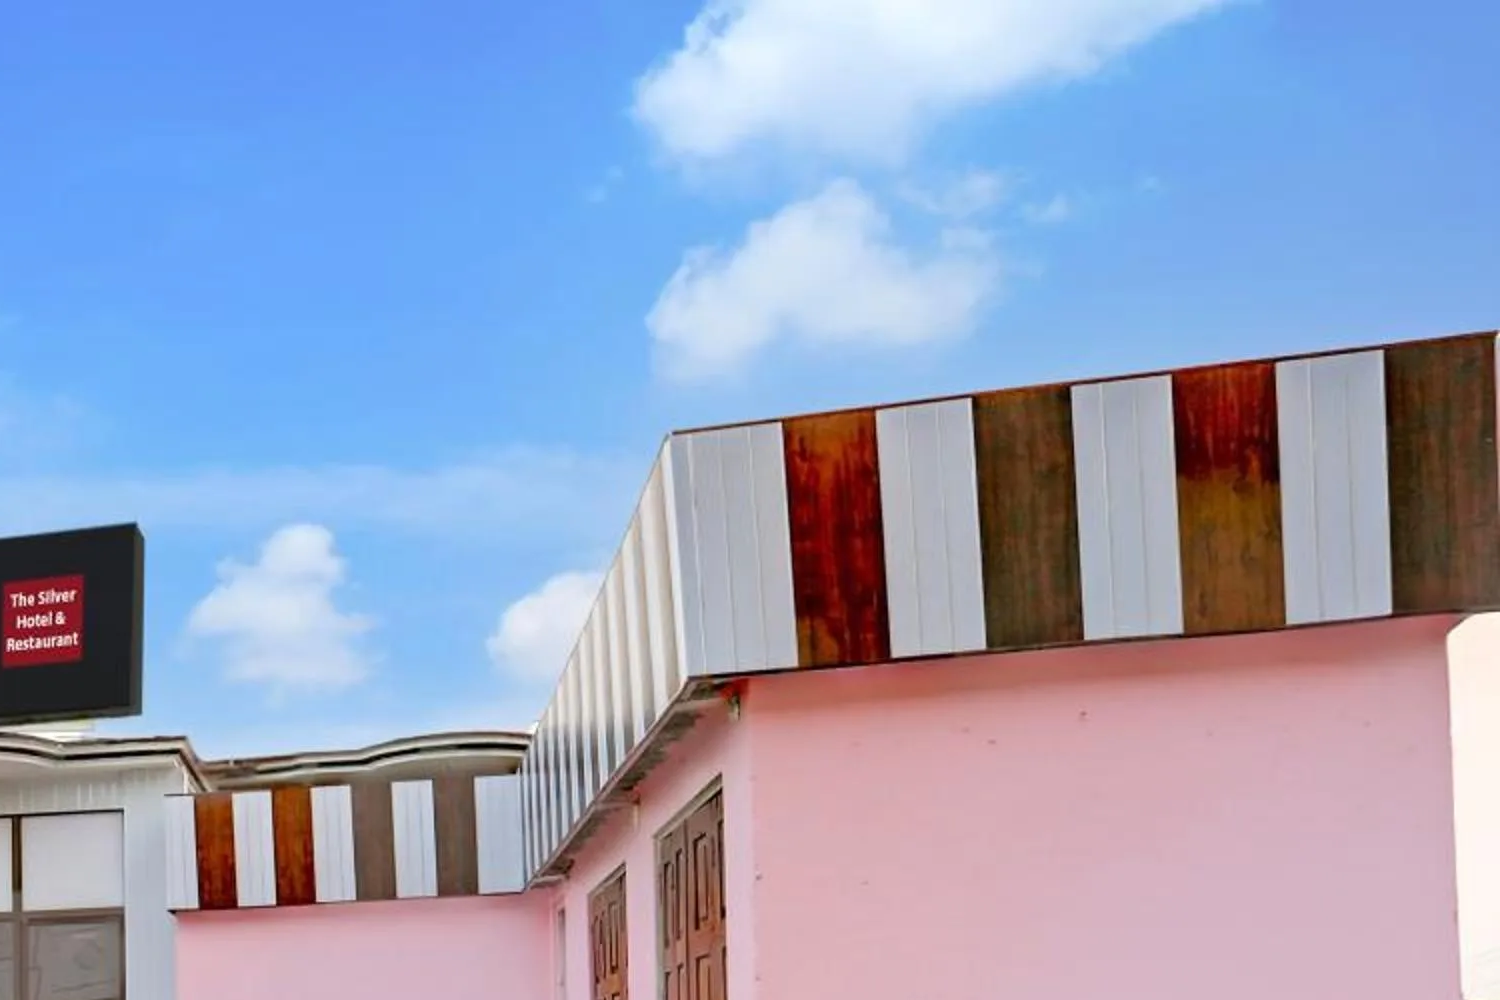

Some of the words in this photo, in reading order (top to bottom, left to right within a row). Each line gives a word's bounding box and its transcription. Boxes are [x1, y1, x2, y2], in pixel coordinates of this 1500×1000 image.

[10, 592, 35, 607] The
[38, 588, 77, 604] Silver
[16, 611, 53, 628] Hotel
[55, 611, 66, 625] &
[6, 632, 78, 652] Restaurant
